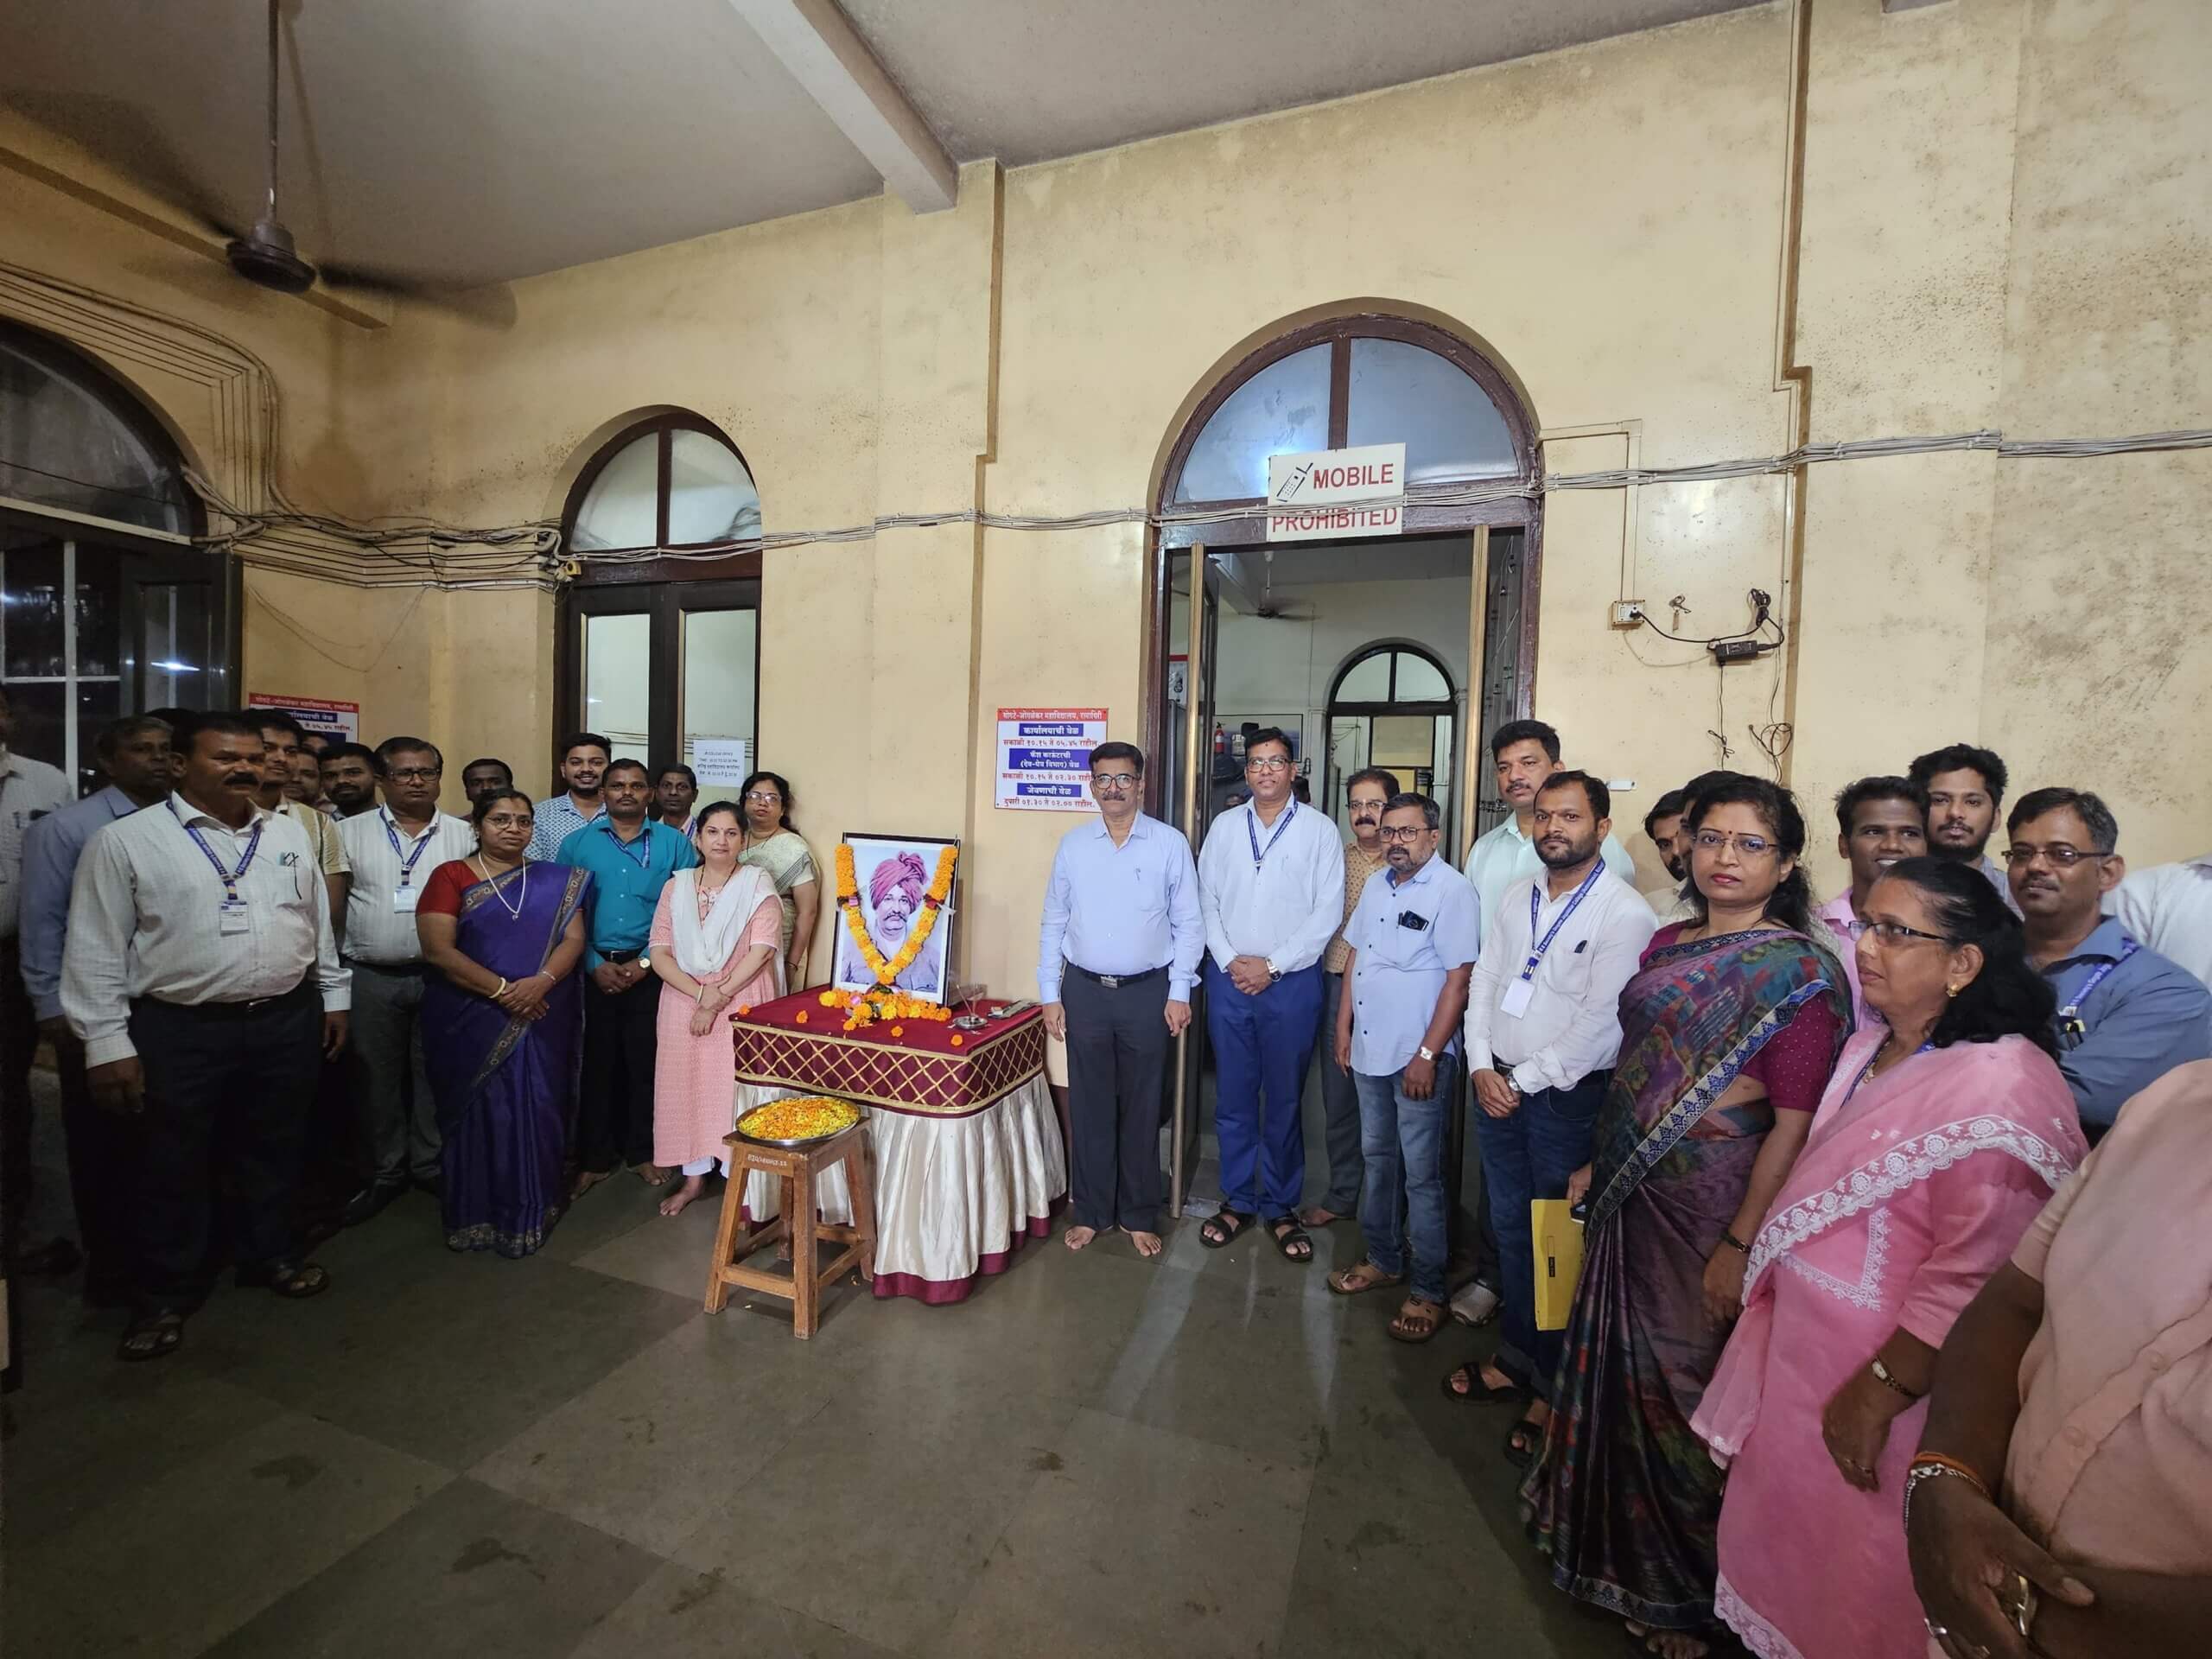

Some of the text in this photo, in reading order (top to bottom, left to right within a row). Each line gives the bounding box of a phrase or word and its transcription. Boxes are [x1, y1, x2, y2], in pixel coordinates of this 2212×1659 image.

[1313, 463, 1394, 490] MOBILE
[1272, 508, 1398, 533] PROHIBITED
[1023, 725, 1079, 735] कार्यालयाची वेळ
[1026, 785, 1072, 796] जेवणाची वेळ
